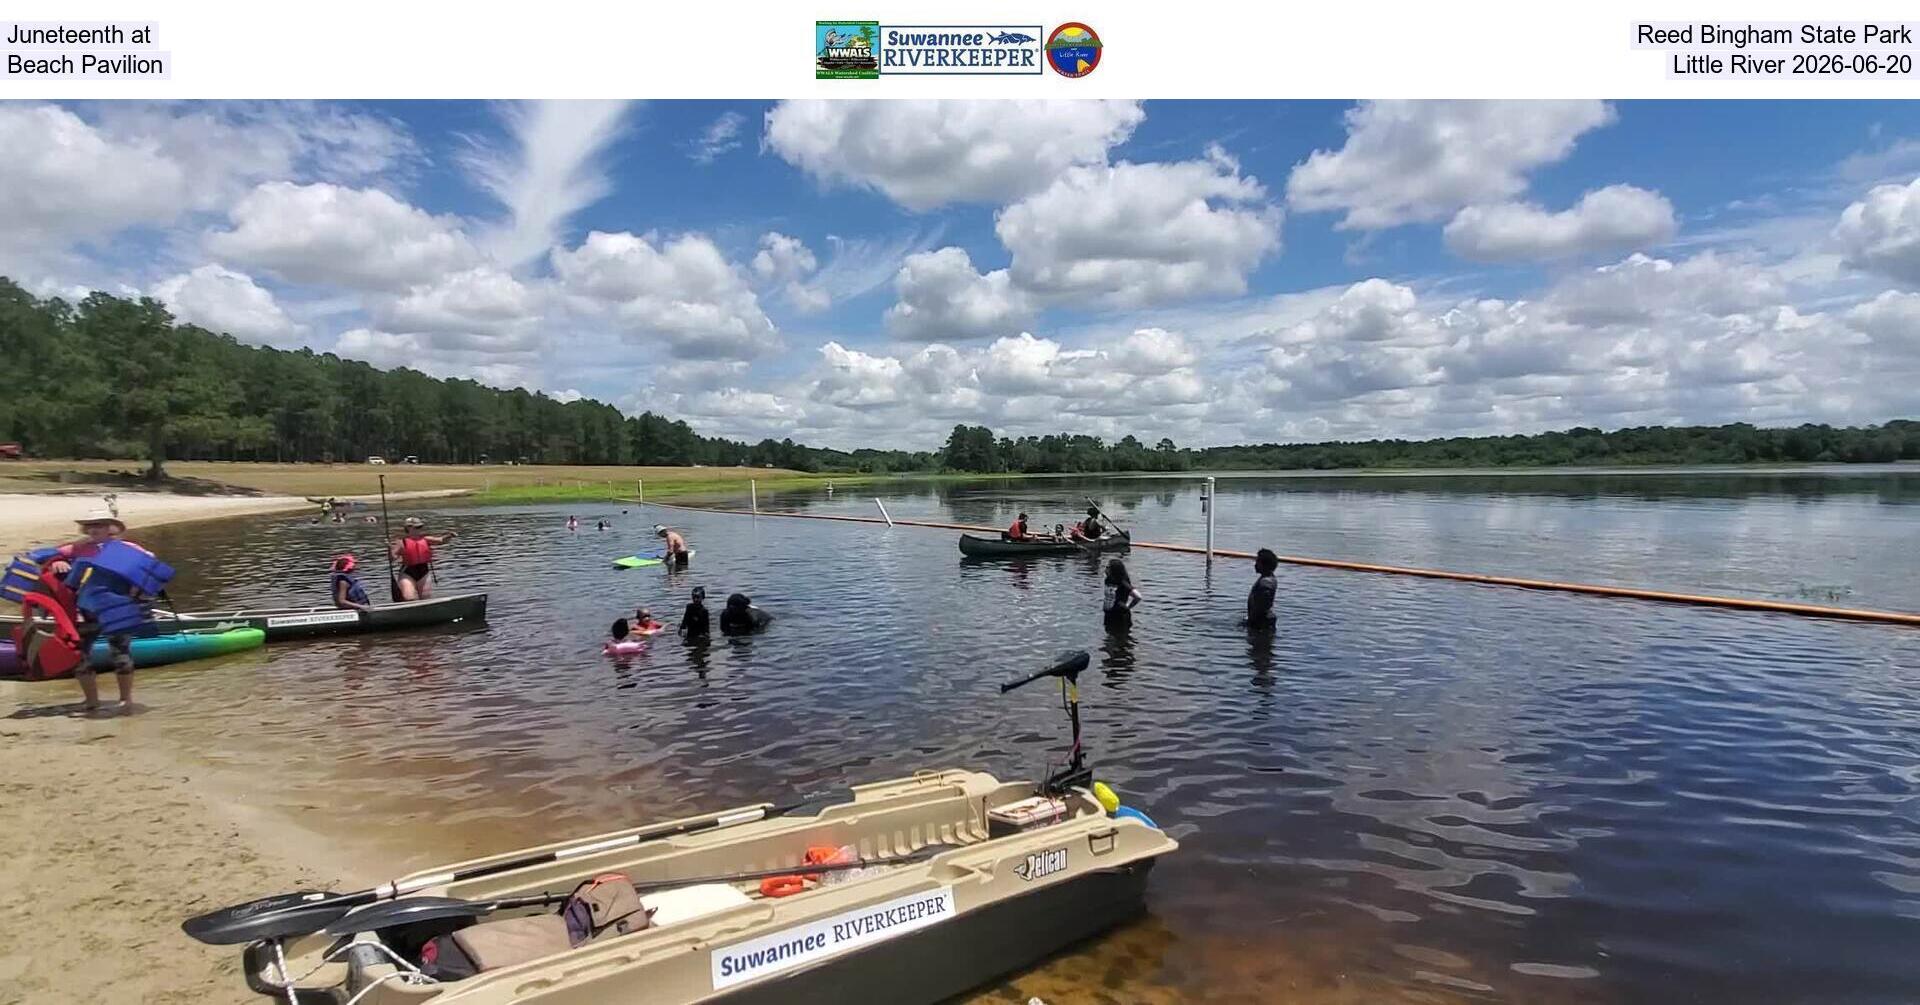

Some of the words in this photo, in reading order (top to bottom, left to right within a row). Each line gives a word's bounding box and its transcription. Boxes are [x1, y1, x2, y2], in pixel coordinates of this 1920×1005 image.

[1022, 848, 1067, 881] Pelican
[720, 932, 826, 977] Suwannee
[832, 896, 945, 943] RIVERKEEPER
